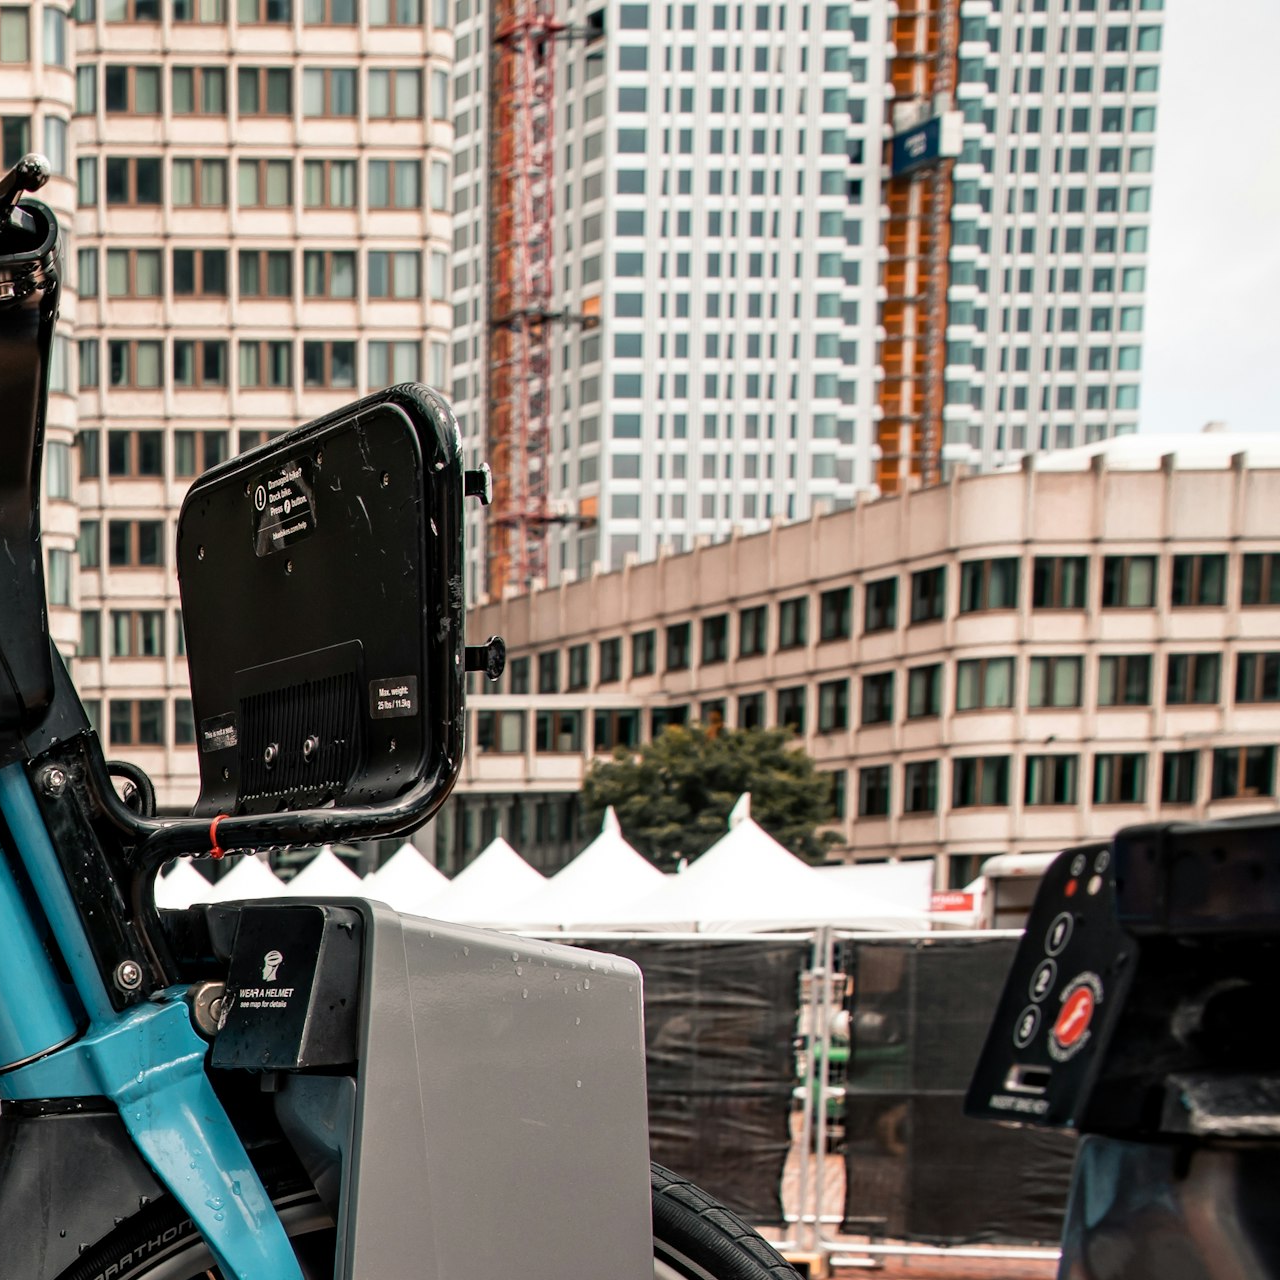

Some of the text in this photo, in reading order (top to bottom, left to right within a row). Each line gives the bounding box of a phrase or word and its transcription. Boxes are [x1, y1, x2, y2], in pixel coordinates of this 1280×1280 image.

[268, 467, 302, 490] Damaged bike?
[269, 487, 293, 503] Dock bike.
[270, 495, 307, 517] Press button.
[378, 687, 391, 697] Max.
[378, 701, 385, 710] 25
[1053, 923, 1065, 945] 1
[1035, 969, 1051, 992] 2
[239, 988, 294, 998] WEAR A HELMET
[250, 1001, 260, 1009] map
[261, 1000, 269, 1008] for
[269, 1000, 287, 1008] details
[1020, 1015, 1034, 1038] 3
